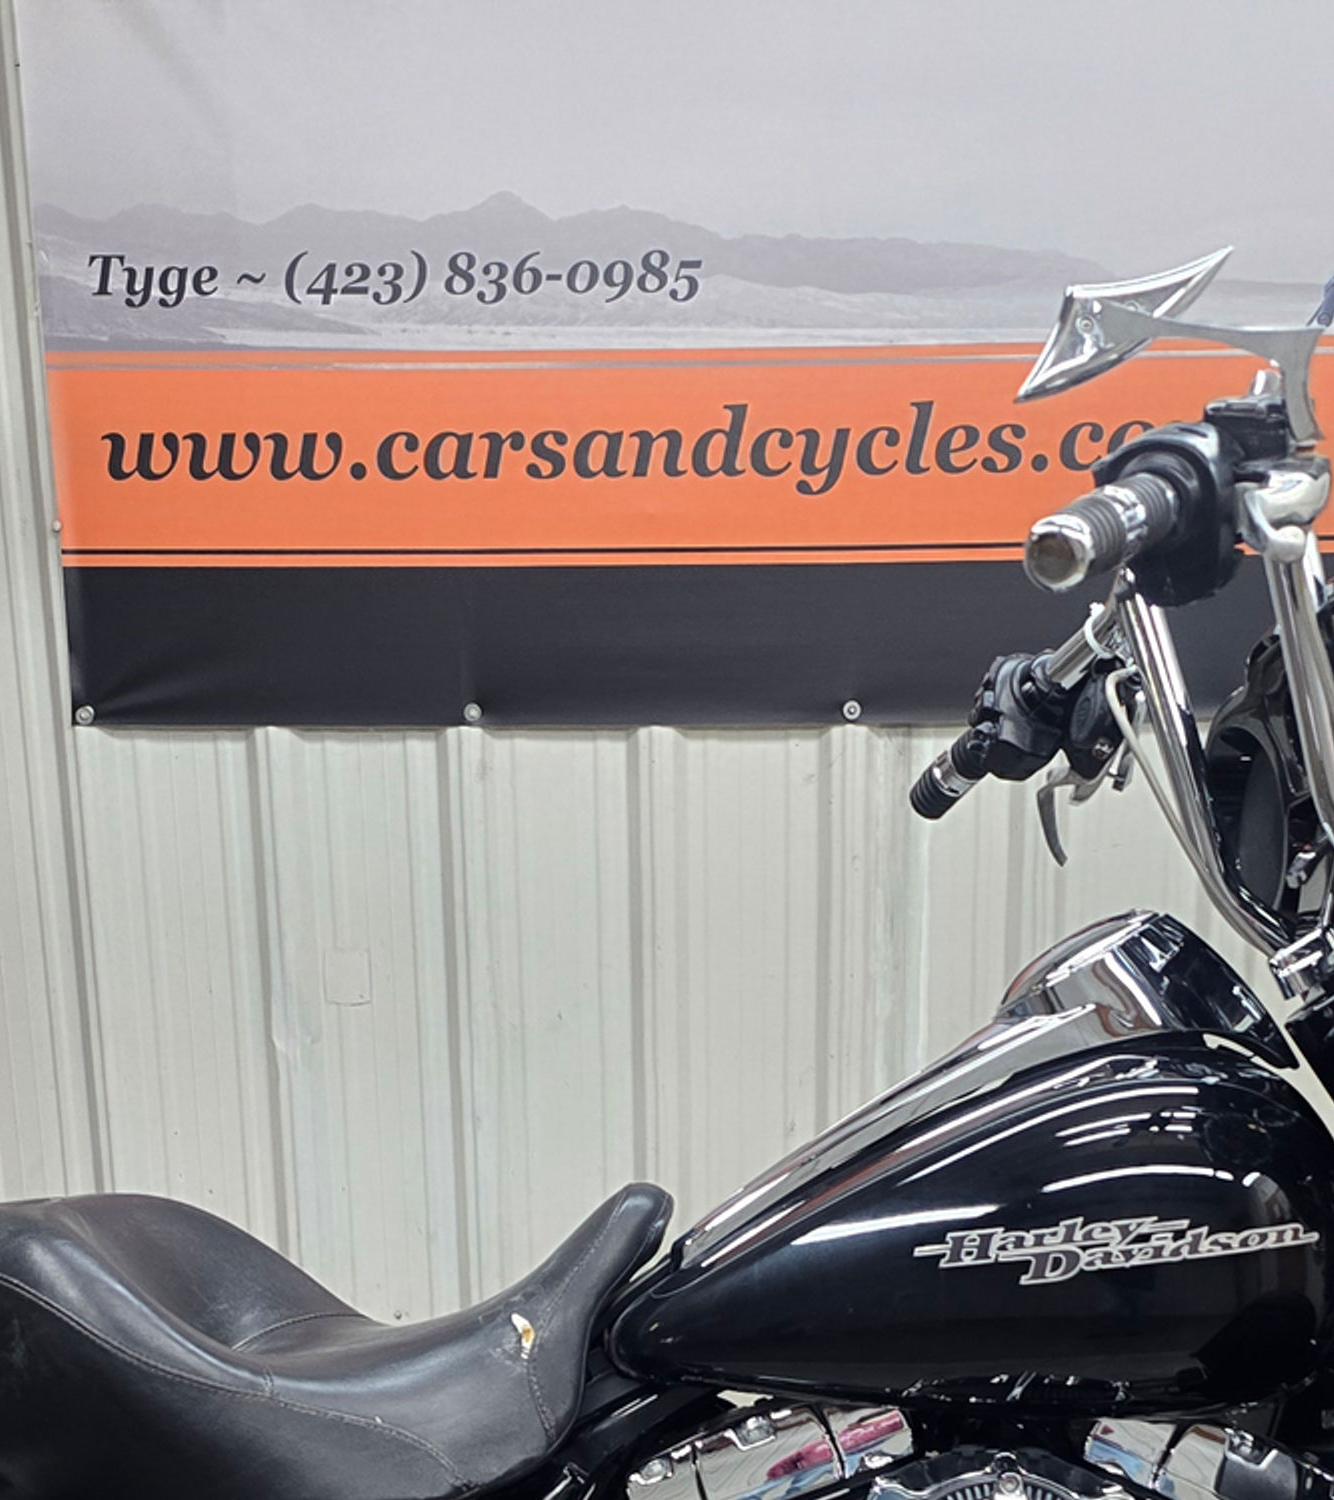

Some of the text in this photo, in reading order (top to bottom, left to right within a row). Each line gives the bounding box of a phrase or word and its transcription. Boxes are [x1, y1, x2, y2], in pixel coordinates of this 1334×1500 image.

[88, 254, 219, 308] Tyge
[283, 251, 428, 304] (423)
[444, 249, 703, 302] 836-0985
[100, 400, 1182, 496] www.carsandcycles.c
[1018, 1222, 1319, 1285] Davidson
